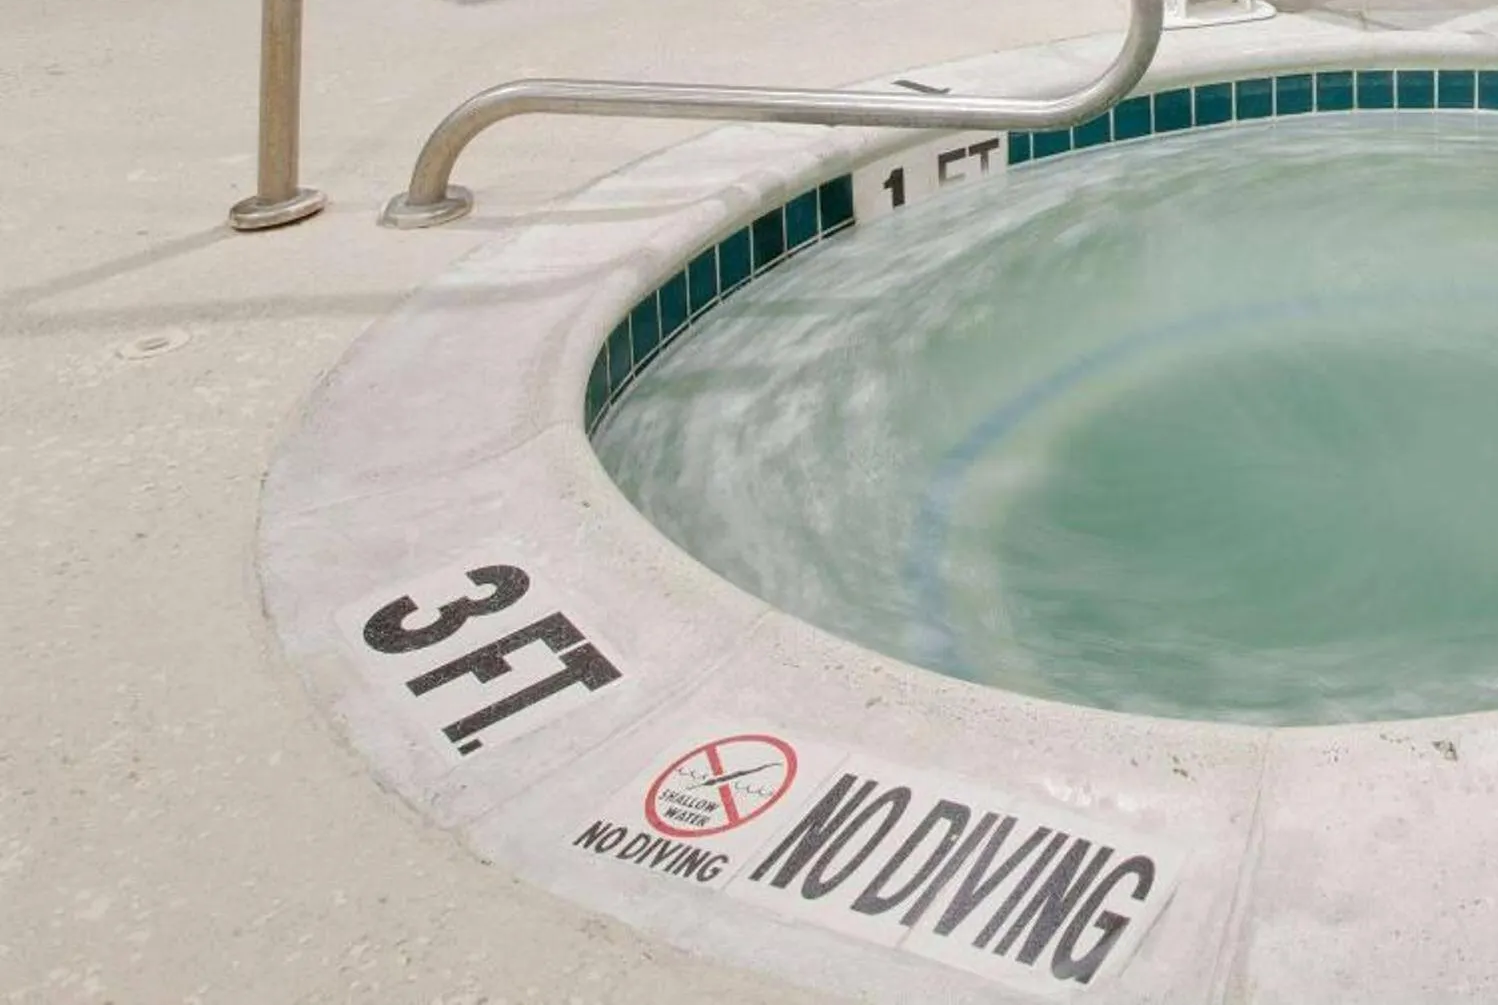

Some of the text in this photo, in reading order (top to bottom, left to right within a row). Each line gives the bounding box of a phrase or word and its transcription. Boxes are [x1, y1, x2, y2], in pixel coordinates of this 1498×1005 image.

[883, 166, 906, 209] 1
[363, 564, 622, 757] 3 FT.
[659, 788, 720, 813] SHALLOW
[664, 806, 711, 828] WATER
[572, 819, 730, 883] NO DIVING
[748, 773, 1156, 985] NO DIVING
